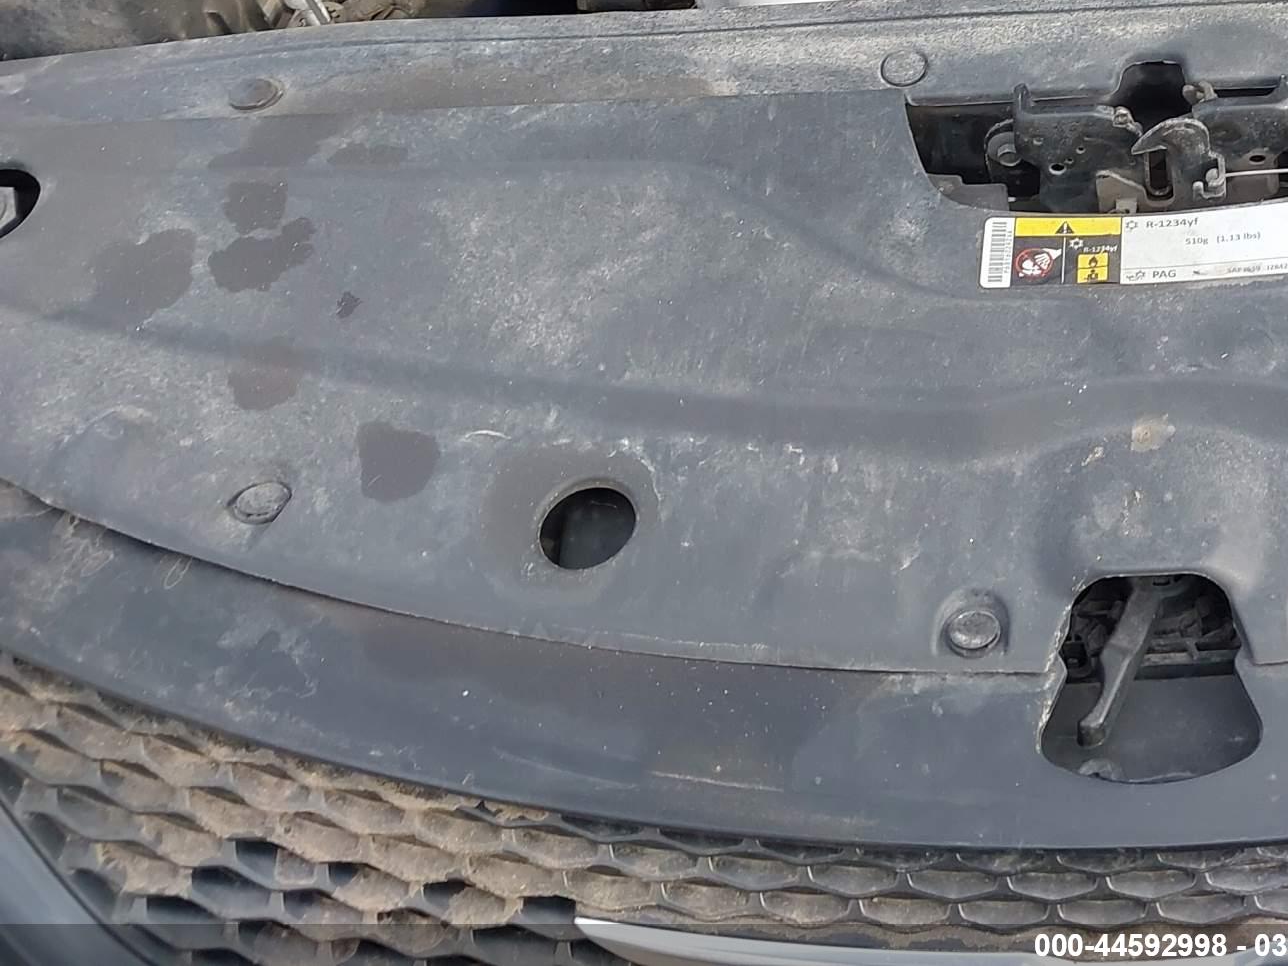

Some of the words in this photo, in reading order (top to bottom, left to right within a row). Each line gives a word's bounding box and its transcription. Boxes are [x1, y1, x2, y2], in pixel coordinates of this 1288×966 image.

[1145, 217, 1199, 230] R-1234yf
[1243, 231, 1262, 241] lbs)
[1151, 268, 1177, 279] PAG
